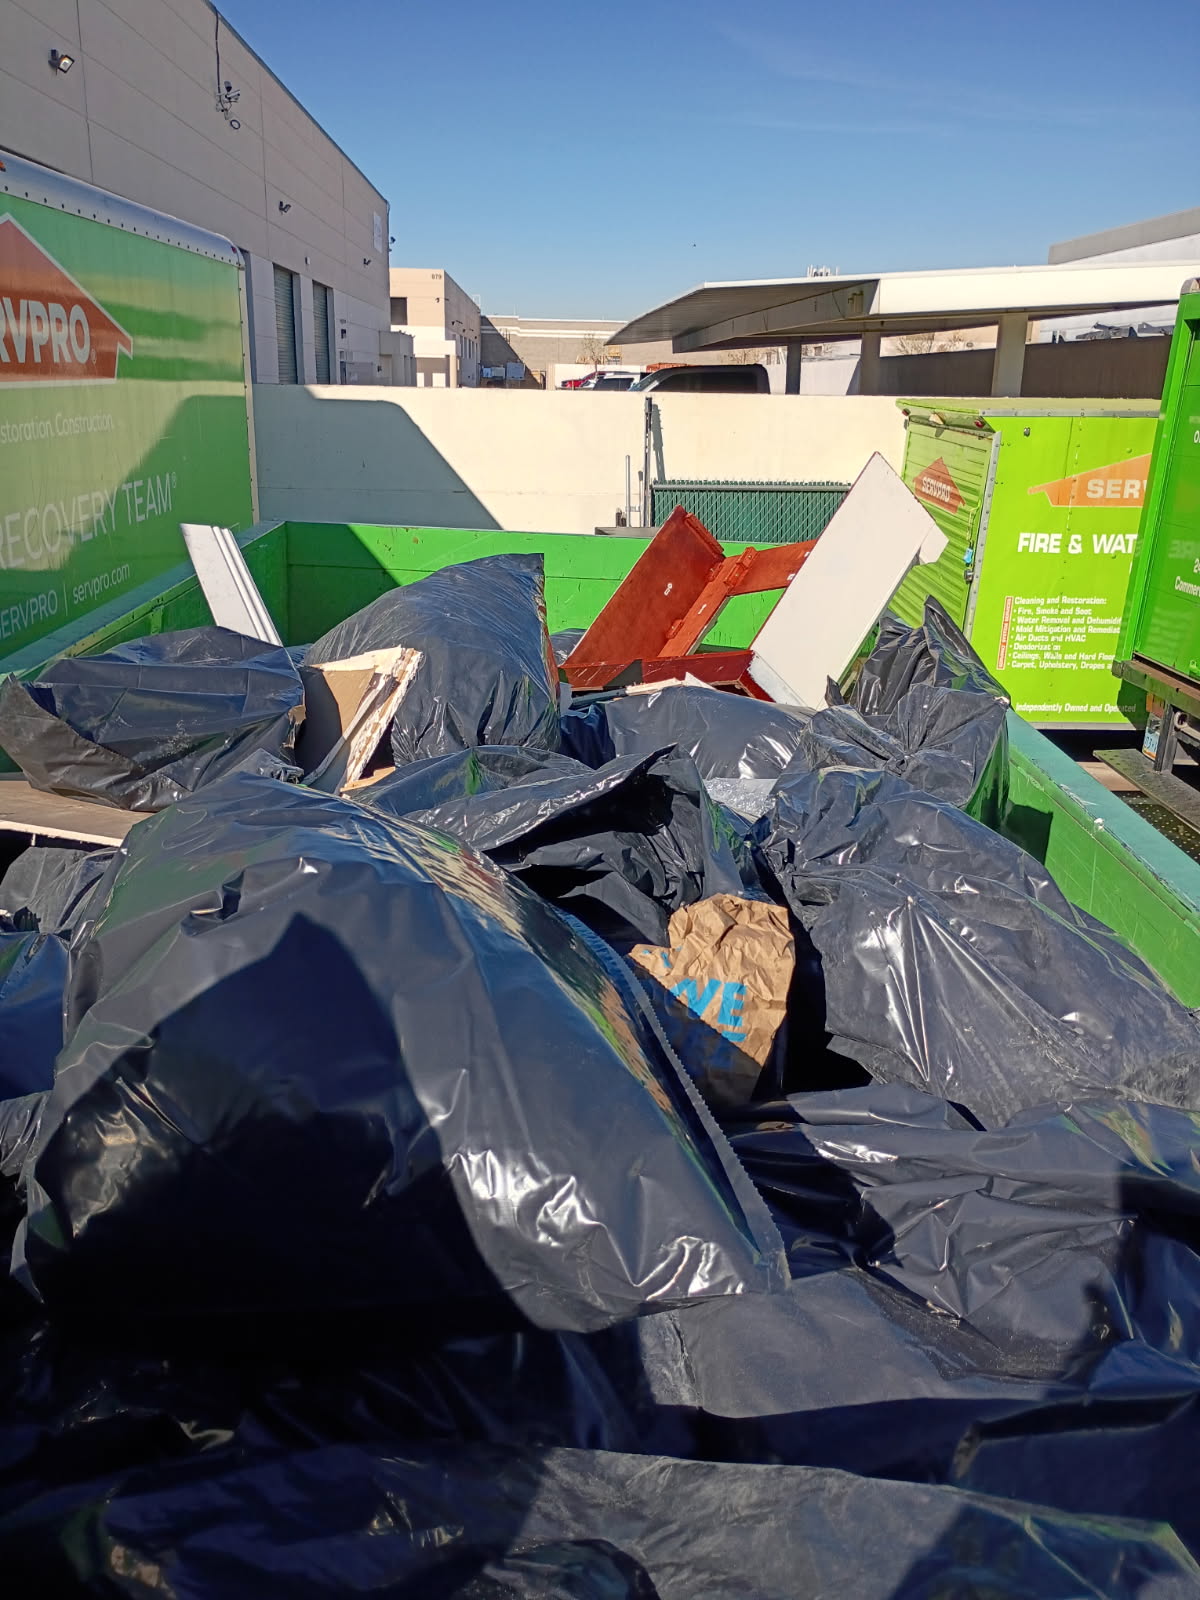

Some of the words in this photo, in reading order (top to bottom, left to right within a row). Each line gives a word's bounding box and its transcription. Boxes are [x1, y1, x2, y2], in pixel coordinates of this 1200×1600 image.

[922, 477, 951, 502] SERVPRO
[0, 487, 118, 570] ECOVERY
[1017, 532, 1062, 554] FIRE
[1067, 534, 1082, 554] &
[1092, 533, 1138, 554] WAT
[72, 564, 131, 605] servpro.com
[1014, 597, 1044, 605] Cleaning
[1061, 596, 1107, 605] Restoration:
[1017, 607, 1033, 616] Fire,
[1036, 607, 1059, 615] Smoke
[1060, 607, 1073, 615] and
[1075, 607, 1092, 615] Soot
[1017, 616, 1039, 624] Water
[1041, 616, 1070, 624] Removal
[1072, 616, 1084, 624] and
[1016, 625, 1033, 633] Mold
[1035, 625, 1071, 634] Mitigation
[1015, 634, 1027, 642] Air
[1028, 634, 1049, 642] Ducts
[1050, 634, 1063, 642] and
[1065, 634, 1087, 642] HVAC
[1064, 652, 1077, 660] and
[1079, 652, 1097, 660] Hard
[1011, 661, 1036, 670] Carpet,
[1039, 661, 1078, 670] Upholstery,
[1080, 661, 1105, 670] Drapes
[1016, 702, 1062, 713] Independently
[1064, 703, 1088, 712] Owned
[1090, 703, 1103, 712] and
